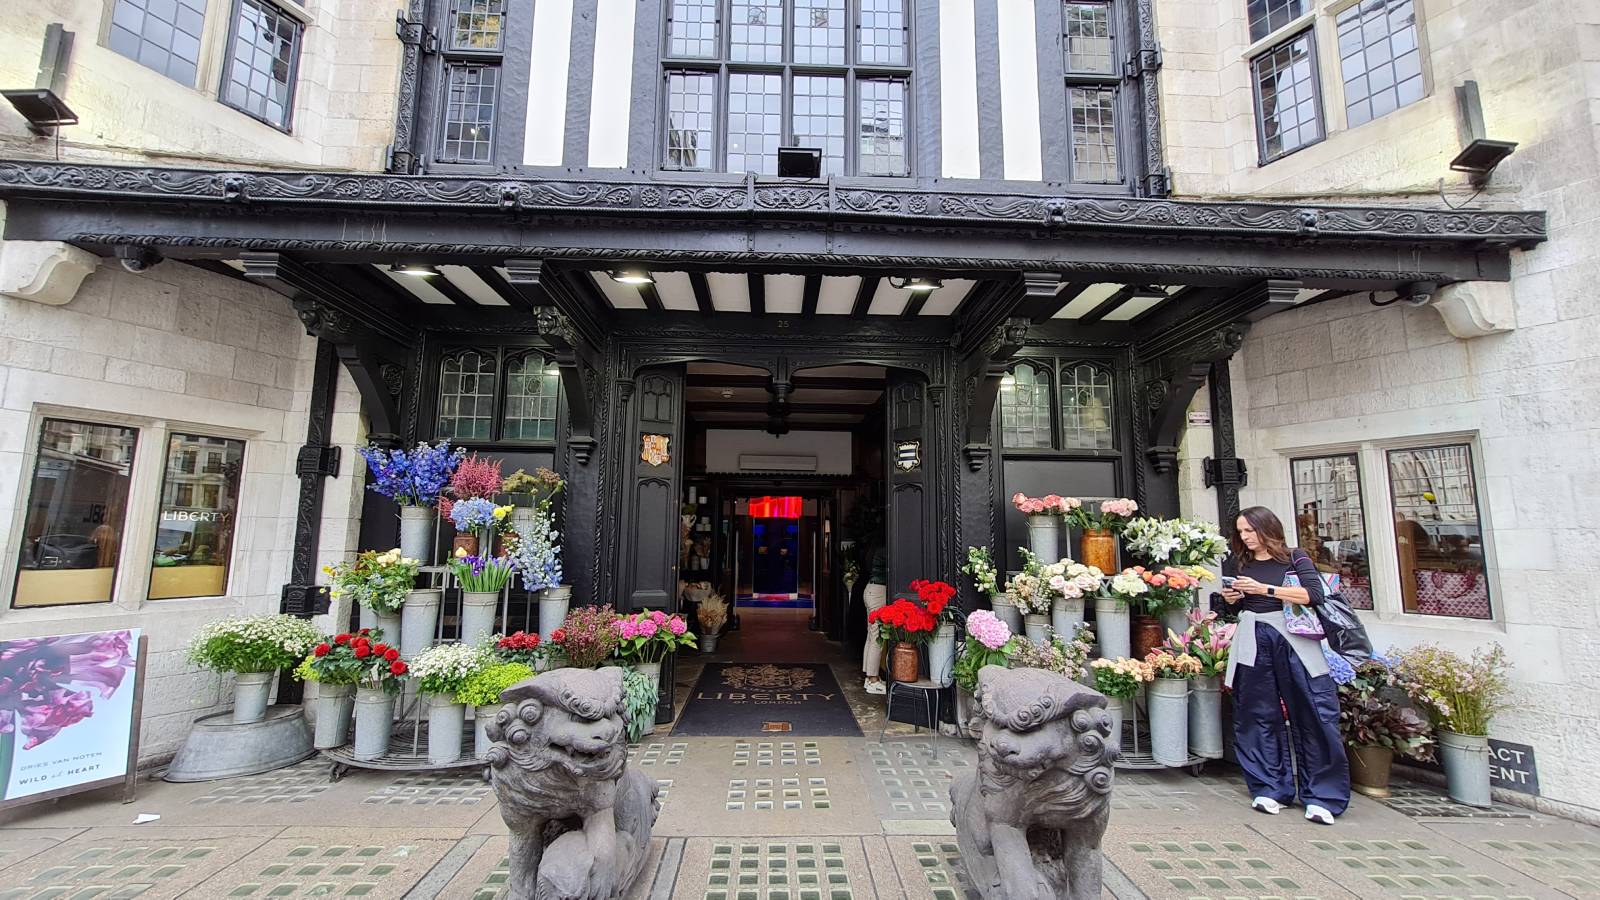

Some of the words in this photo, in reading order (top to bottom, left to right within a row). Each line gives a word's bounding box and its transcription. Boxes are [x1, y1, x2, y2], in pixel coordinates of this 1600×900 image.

[163, 510, 230, 522] LIBERTY
[697, 692, 836, 701] LIBERTY
[52, 757, 70, 765] VAN
[73, 751, 102, 761] NOTEN
[19, 774, 48, 785] WILD
[67, 764, 101, 775] HEART
